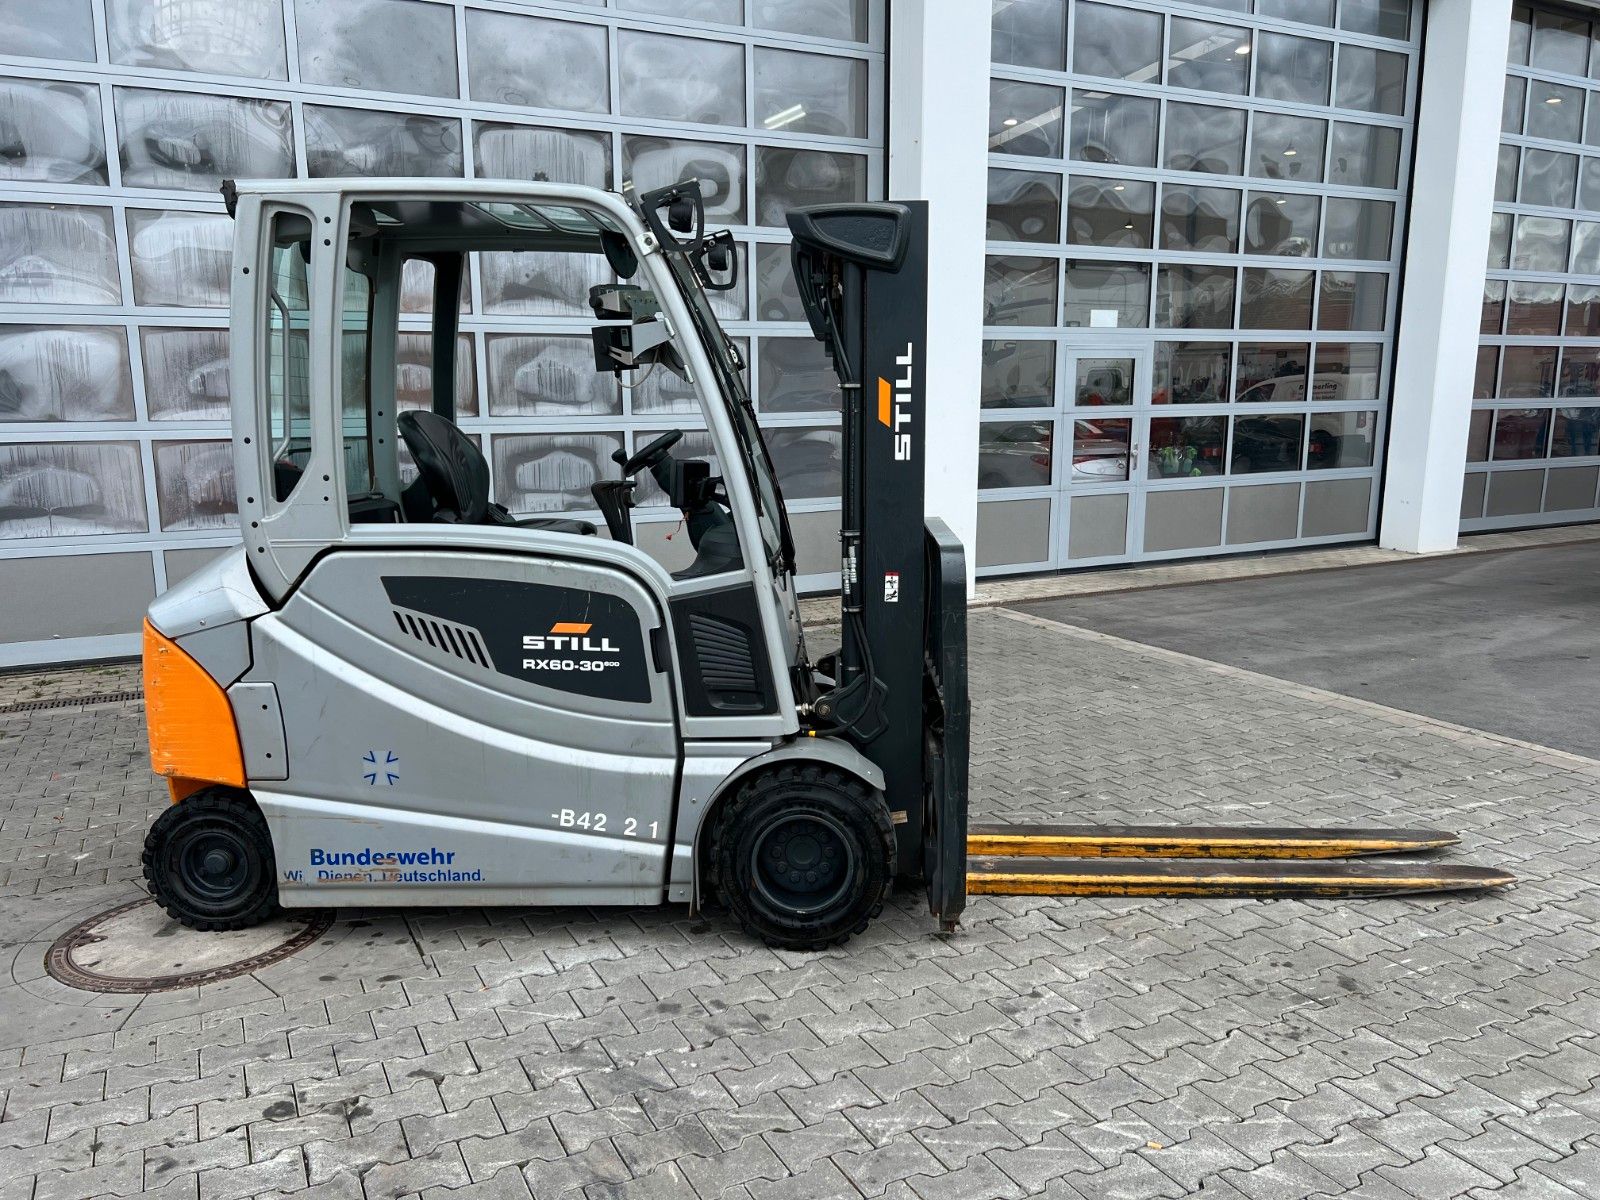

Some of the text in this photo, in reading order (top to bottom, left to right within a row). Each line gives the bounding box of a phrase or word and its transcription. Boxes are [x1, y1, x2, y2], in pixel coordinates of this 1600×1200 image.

[894, 342, 912, 461] STILL
[522, 635, 620, 652] STILL
[310, 847, 456, 866] Bundeswehr
